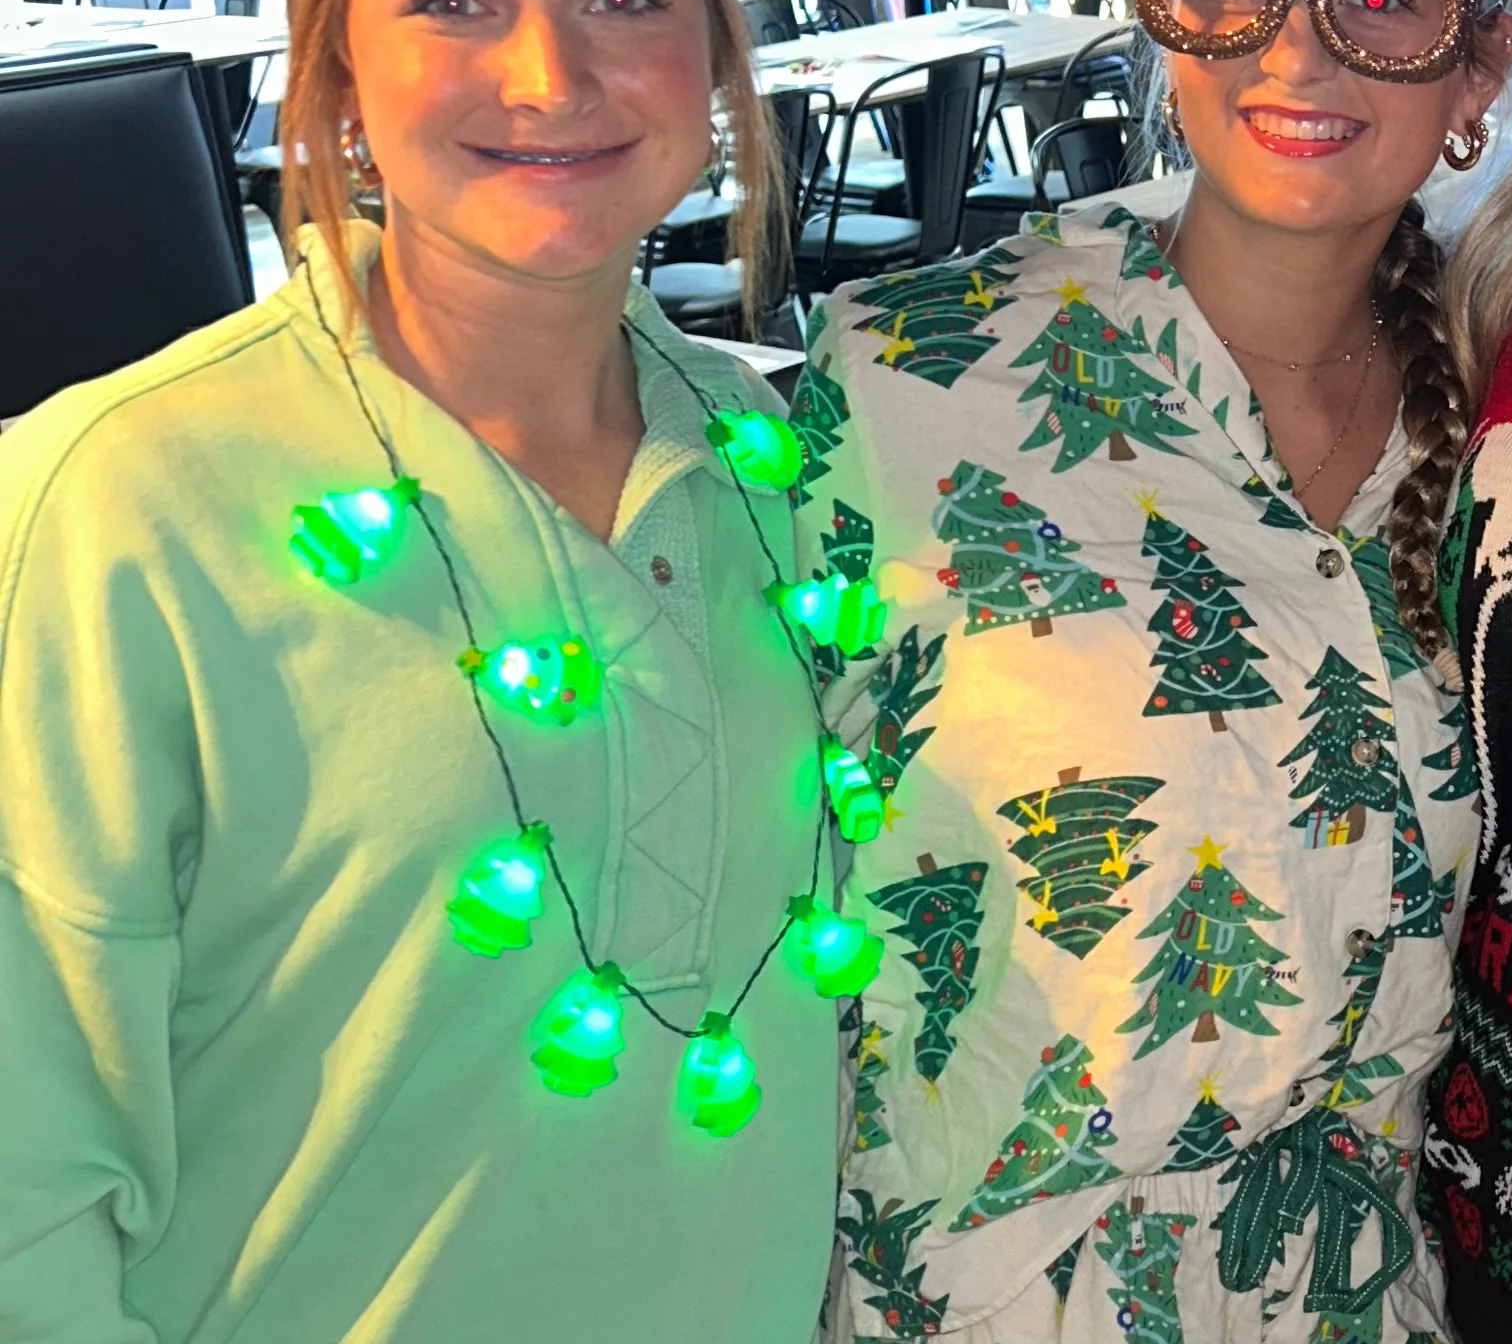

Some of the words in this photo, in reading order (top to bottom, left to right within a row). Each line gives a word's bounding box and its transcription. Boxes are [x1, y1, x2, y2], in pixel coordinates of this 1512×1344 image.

[1052, 343, 1115, 388] OLD
[1176, 910, 1236, 954] OLD
[1168, 952, 1255, 998] NAVY
